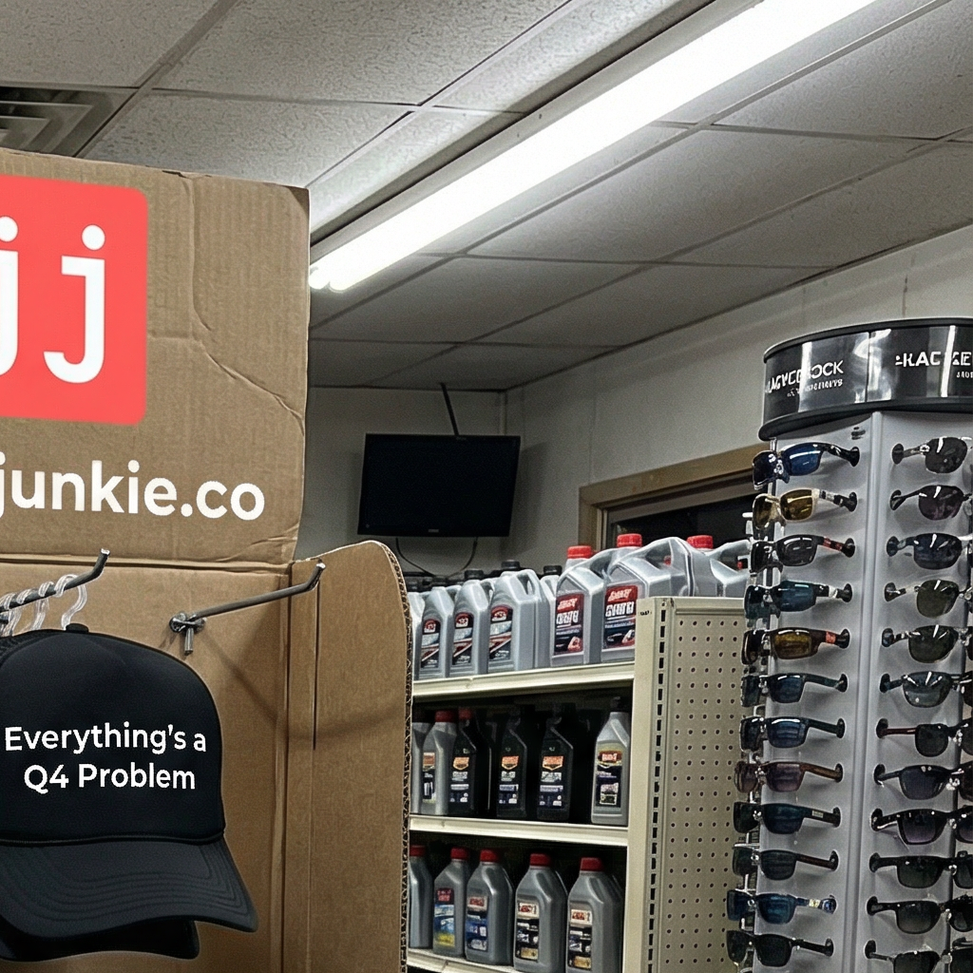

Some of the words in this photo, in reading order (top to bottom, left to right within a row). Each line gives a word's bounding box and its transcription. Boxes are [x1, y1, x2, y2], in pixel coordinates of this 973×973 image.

[4, 720, 187, 755] Everything's
[193, 732, 207, 753] a
[23, 764, 70, 795] Q4
[78, 761, 196, 790] Problem
